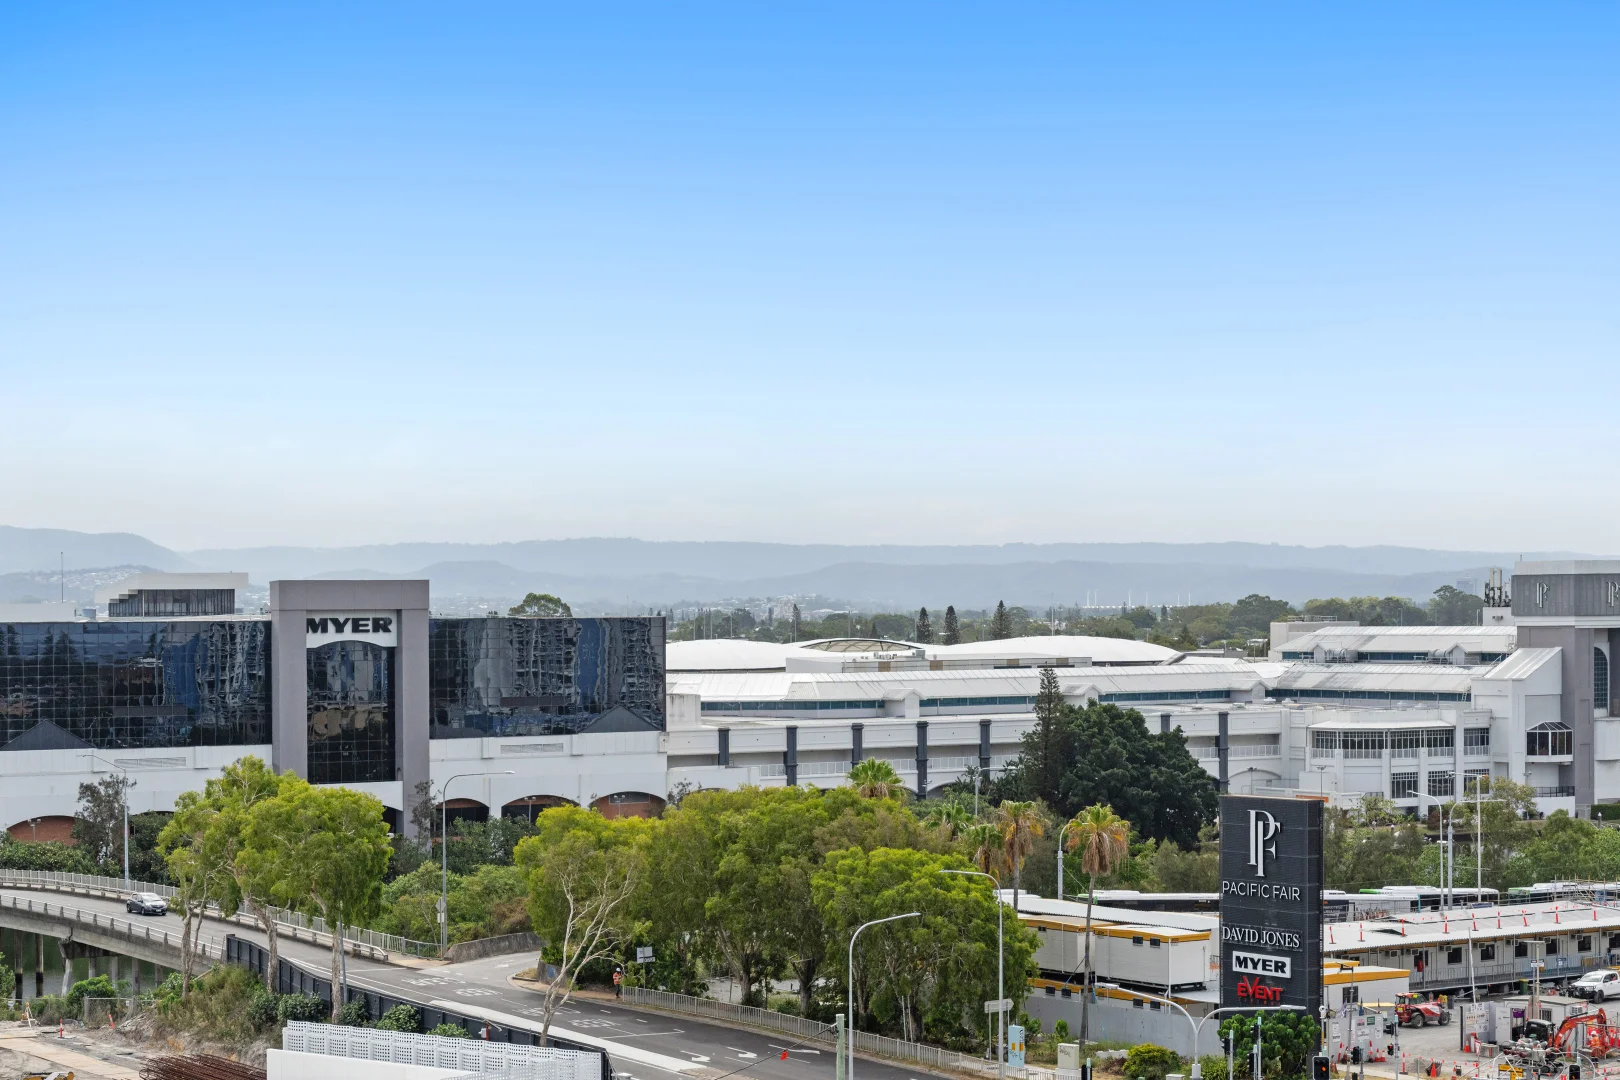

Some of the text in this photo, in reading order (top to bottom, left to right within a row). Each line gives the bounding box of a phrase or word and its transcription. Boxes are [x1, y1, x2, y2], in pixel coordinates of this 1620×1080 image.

[306, 617, 392, 633] MYER
[1222, 880, 1300, 901] PACIFIC FAIR
[1222, 926, 1300, 948] DAVID JONES
[1235, 955, 1287, 974] MYER
